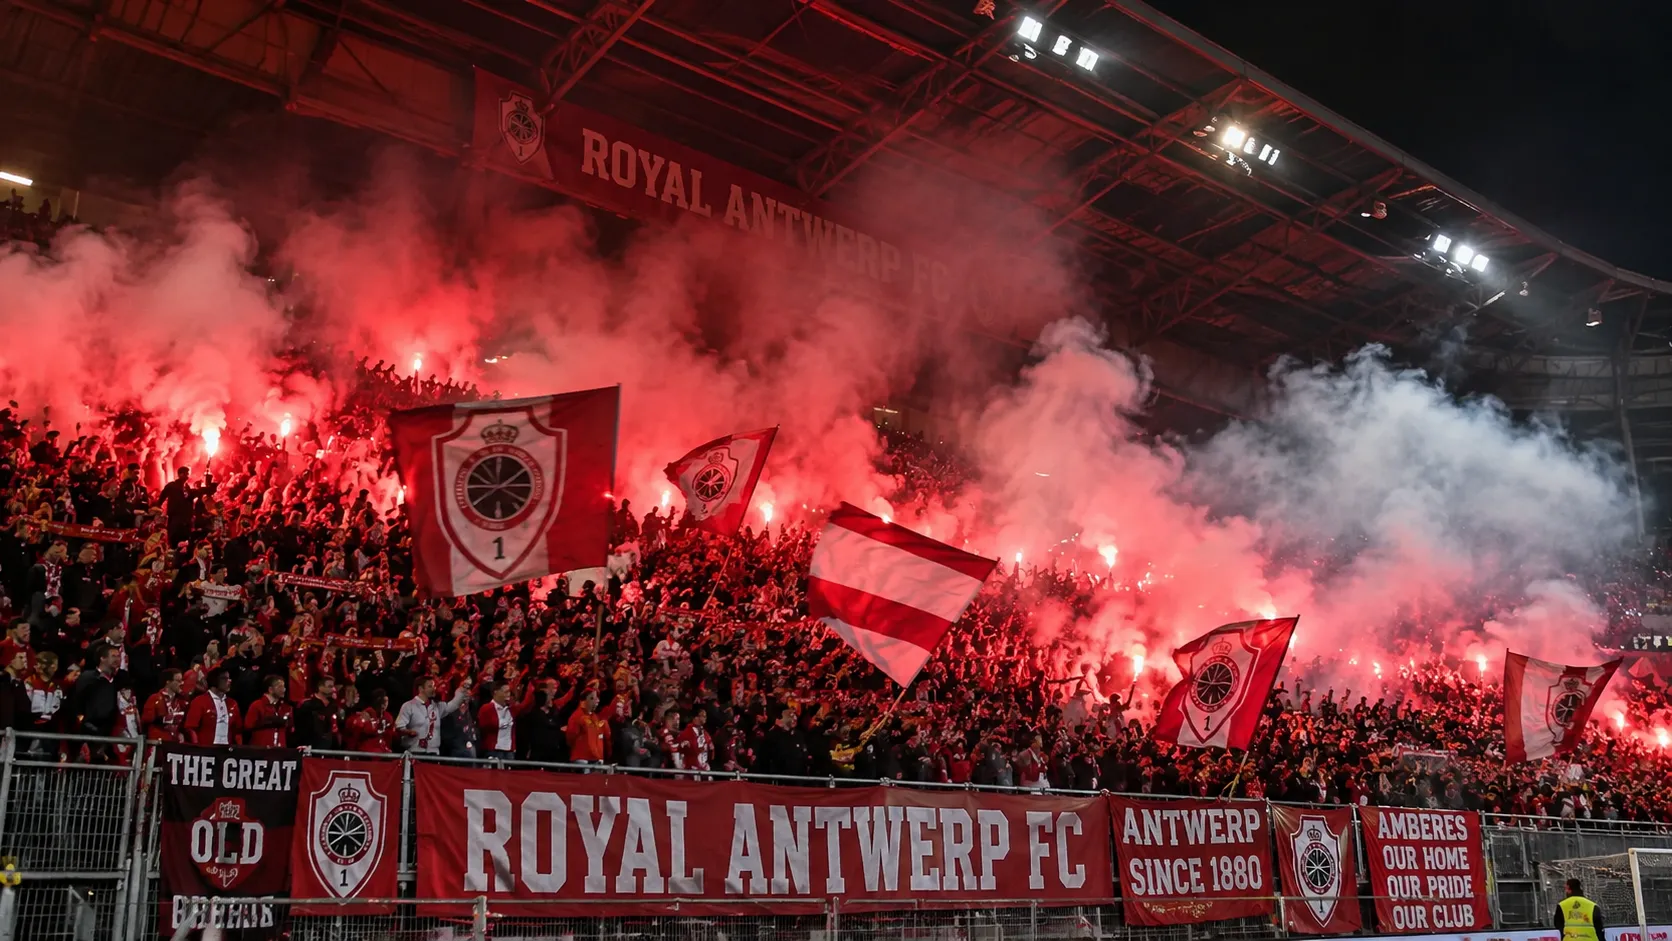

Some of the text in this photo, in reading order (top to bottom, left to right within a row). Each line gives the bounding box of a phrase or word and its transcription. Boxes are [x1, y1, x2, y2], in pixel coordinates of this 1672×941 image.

[581, 128, 951, 302] ROYAL ANTWERP FC
[492, 536, 505, 560] 1
[1203, 715, 1211, 731] 1
[167, 753, 297, 791] THE GREAT
[463, 788, 704, 894] ROYAL
[724, 803, 1010, 894] ANTWERP
[1026, 811, 1086, 889] FC
[1122, 807, 1261, 846] ANTWERP
[1378, 811, 1468, 841] AMBERES
[191, 819, 264, 865] OLD
[1382, 845, 1470, 870] OUR HOME
[339, 868, 349, 887] 1
[1129, 857, 1205, 896] SINCE
[1212, 854, 1263, 891] 1880
[1387, 875, 1474, 900] OUR PRIDE
[1392, 904, 1475, 930] OUR CLUB
